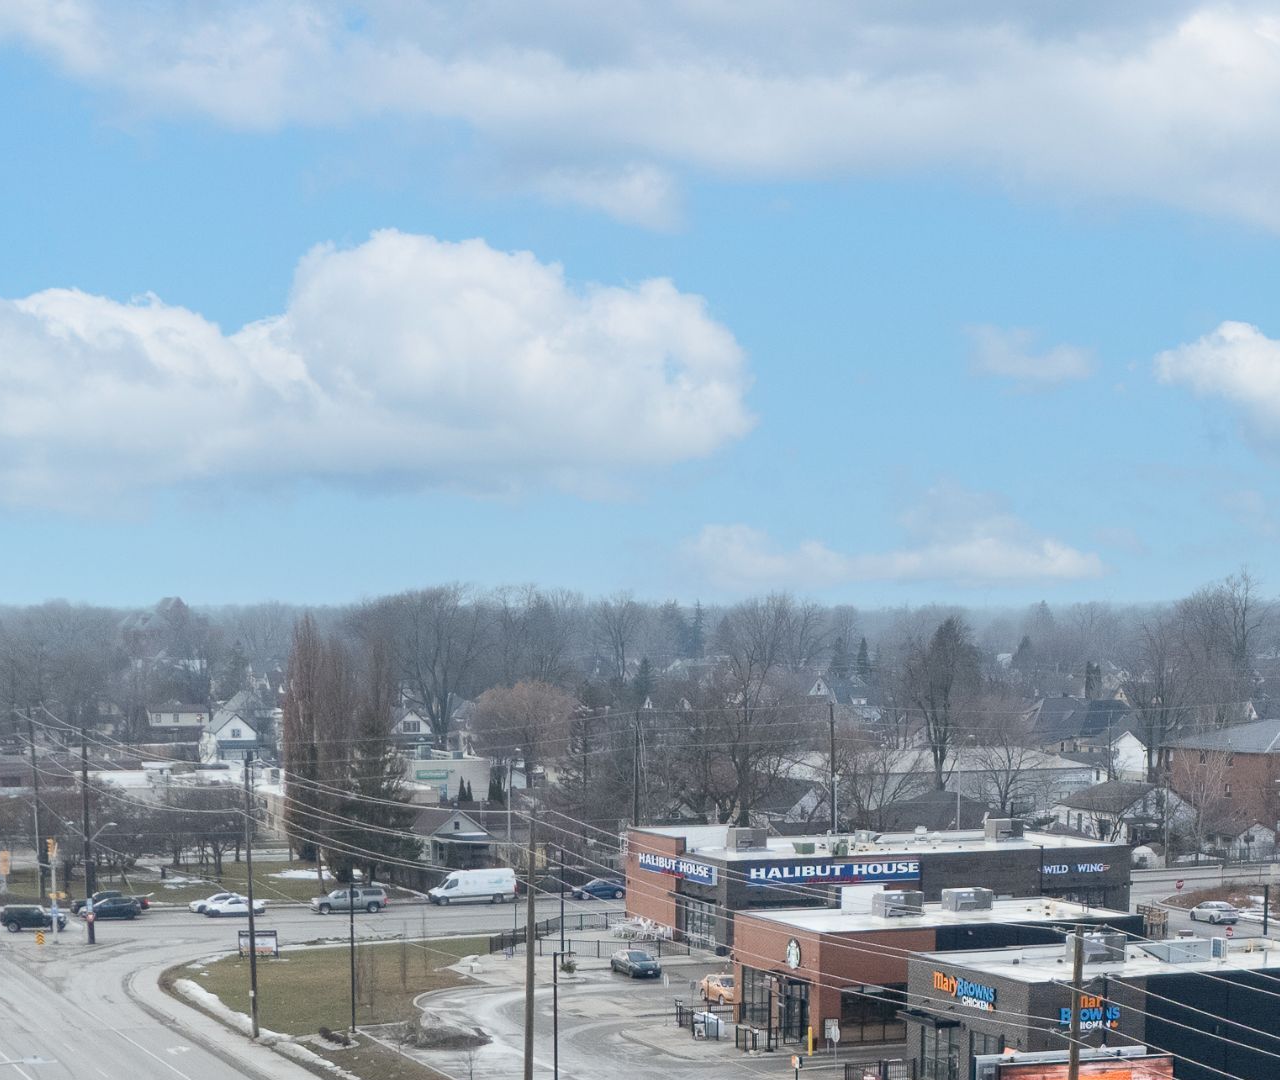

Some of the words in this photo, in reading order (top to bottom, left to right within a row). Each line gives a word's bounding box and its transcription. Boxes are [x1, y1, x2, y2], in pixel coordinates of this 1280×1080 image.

[639, 853, 677, 871] HALIBUT
[680, 861, 709, 878] HOUSE
[750, 865, 845, 880] HALIBUT
[852, 863, 919, 875] HOUSE
[1043, 864, 1069, 874] WILD
[1077, 863, 1104, 873] WING
[961, 995, 989, 1011] CHICKEN
